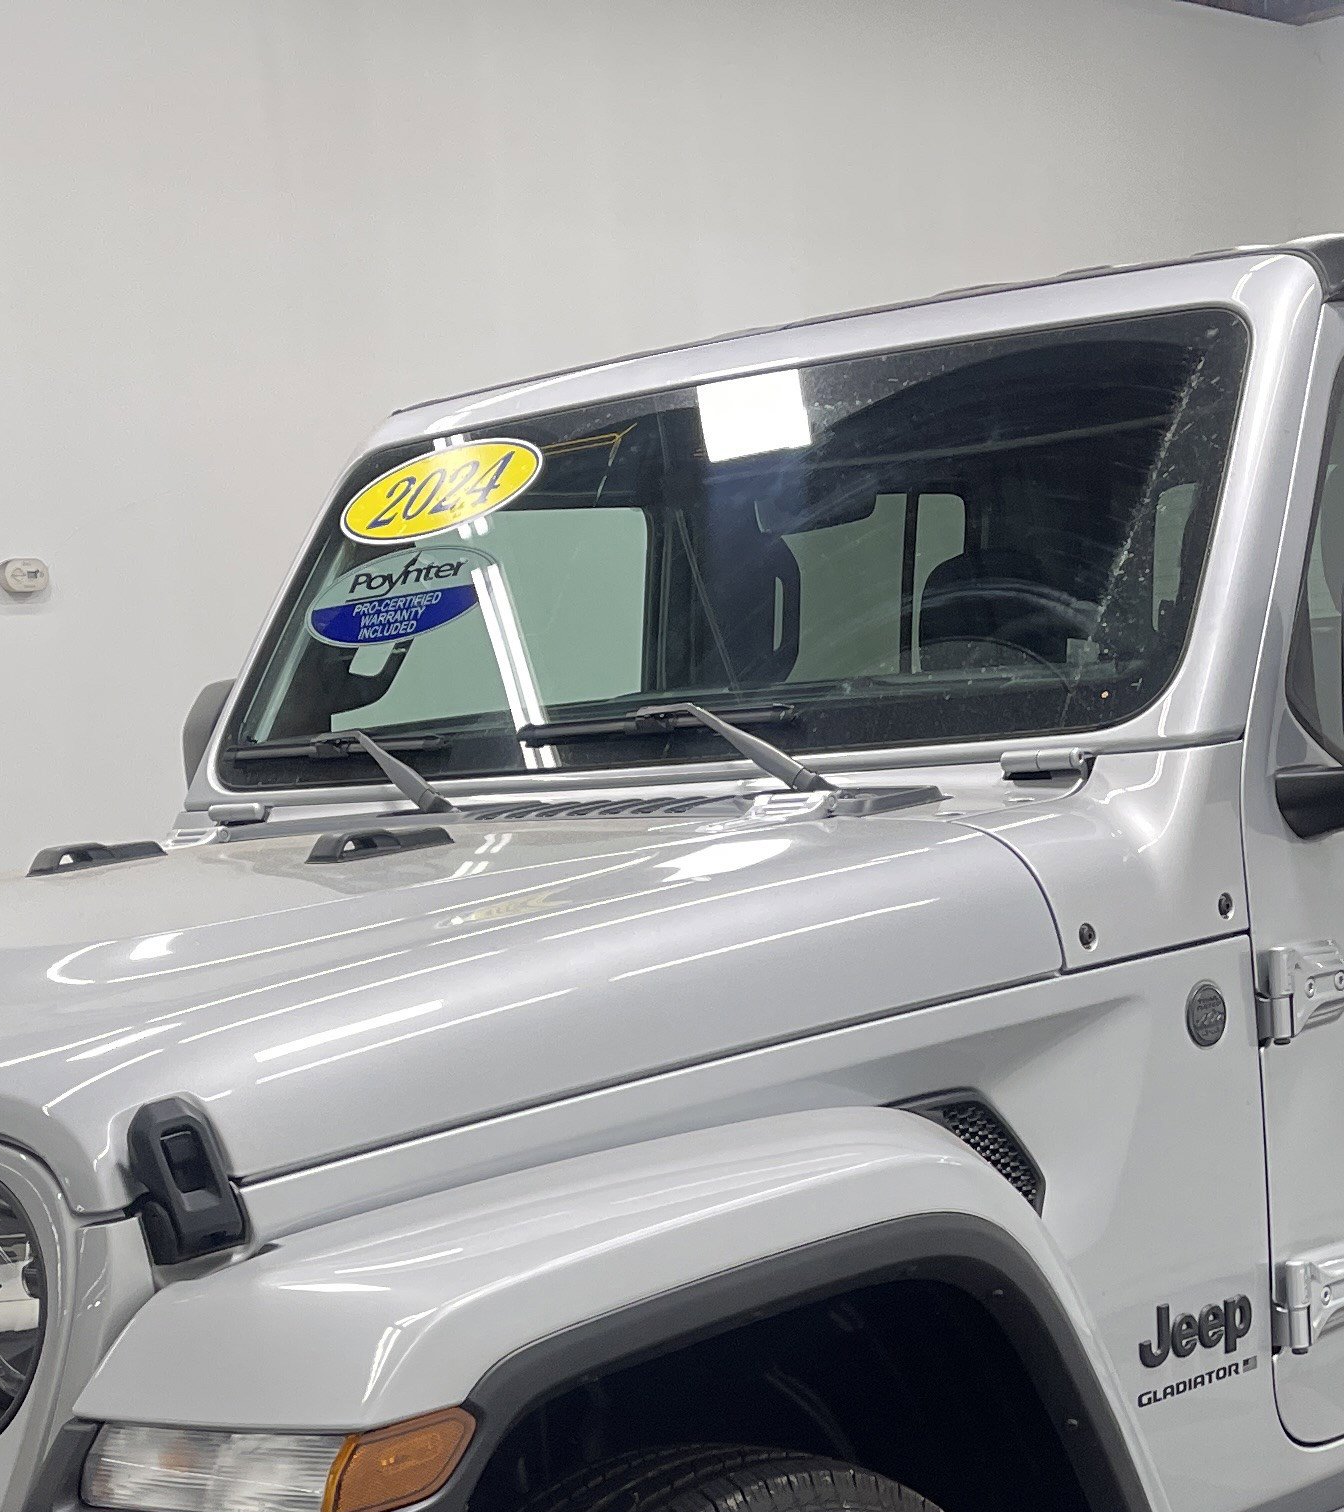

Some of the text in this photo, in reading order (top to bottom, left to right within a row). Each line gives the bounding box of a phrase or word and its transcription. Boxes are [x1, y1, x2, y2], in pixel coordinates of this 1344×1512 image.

[366, 450, 516, 530] 2024
[346, 553, 469, 602] Poynter
[353, 591, 442, 616] PRO-CERTIFIED
[360, 606, 426, 627] WARRANTY
[358, 621, 417, 640] INCLUDED
[1138, 1294, 1253, 1369] Jeep
[1137, 1362, 1241, 1408] GLADIATOR
